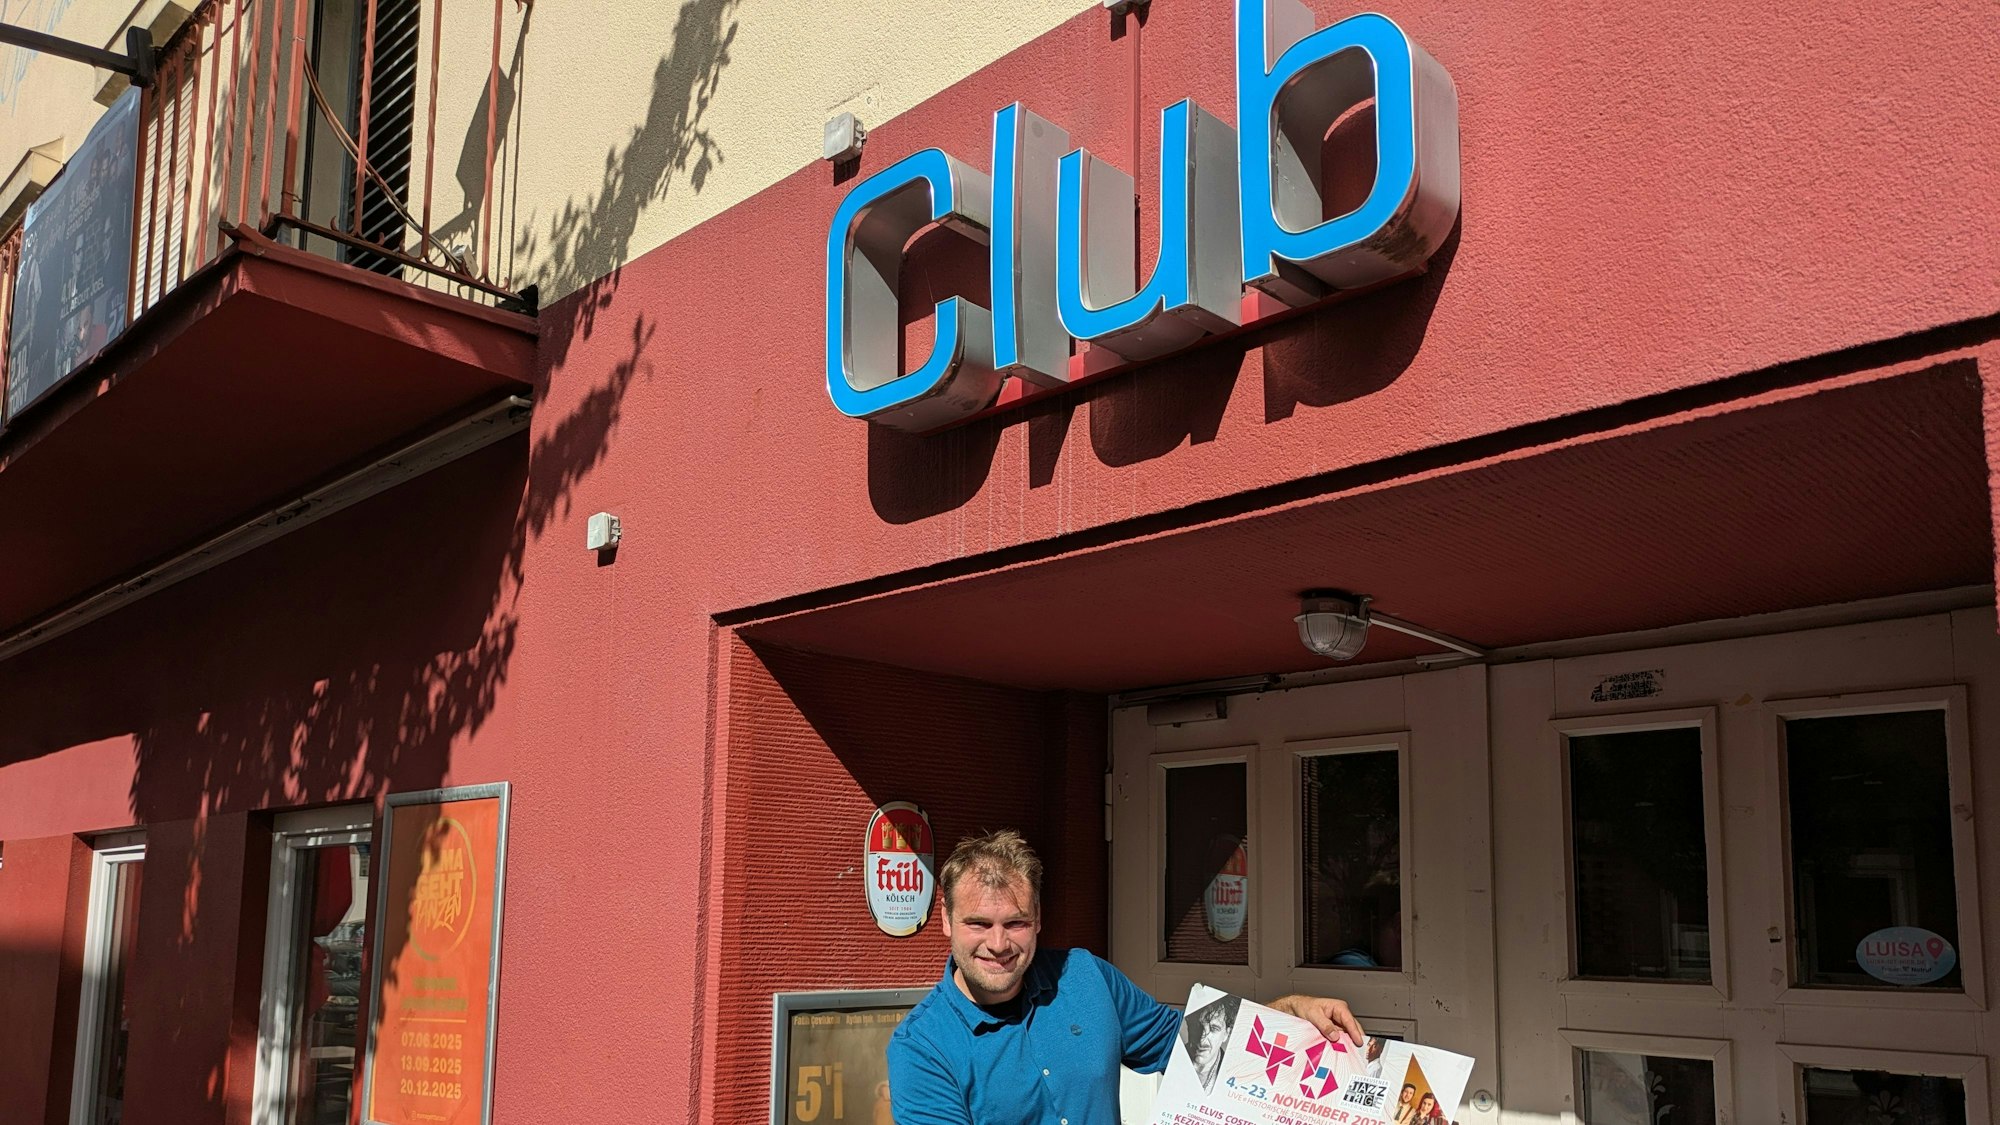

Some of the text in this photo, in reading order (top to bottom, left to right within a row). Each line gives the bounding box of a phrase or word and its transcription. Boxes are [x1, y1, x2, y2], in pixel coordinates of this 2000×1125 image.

[826, 0, 1446, 420] Club
[885, 894, 915, 903] KÖLSCH
[1865, 941, 1924, 956] LUISA
[401, 1031, 462, 1051] 07.06.2025
[401, 1055, 461, 1075] 13.09.2025
[400, 1078, 461, 1100] 20.12.2025
[1348, 1081, 1387, 1097] JAZZ
[1199, 1105, 1224, 1120] ELVIS
[1272, 1093, 1350, 1124] NOVEMBER
[1275, 1114, 1294, 1125] JON
